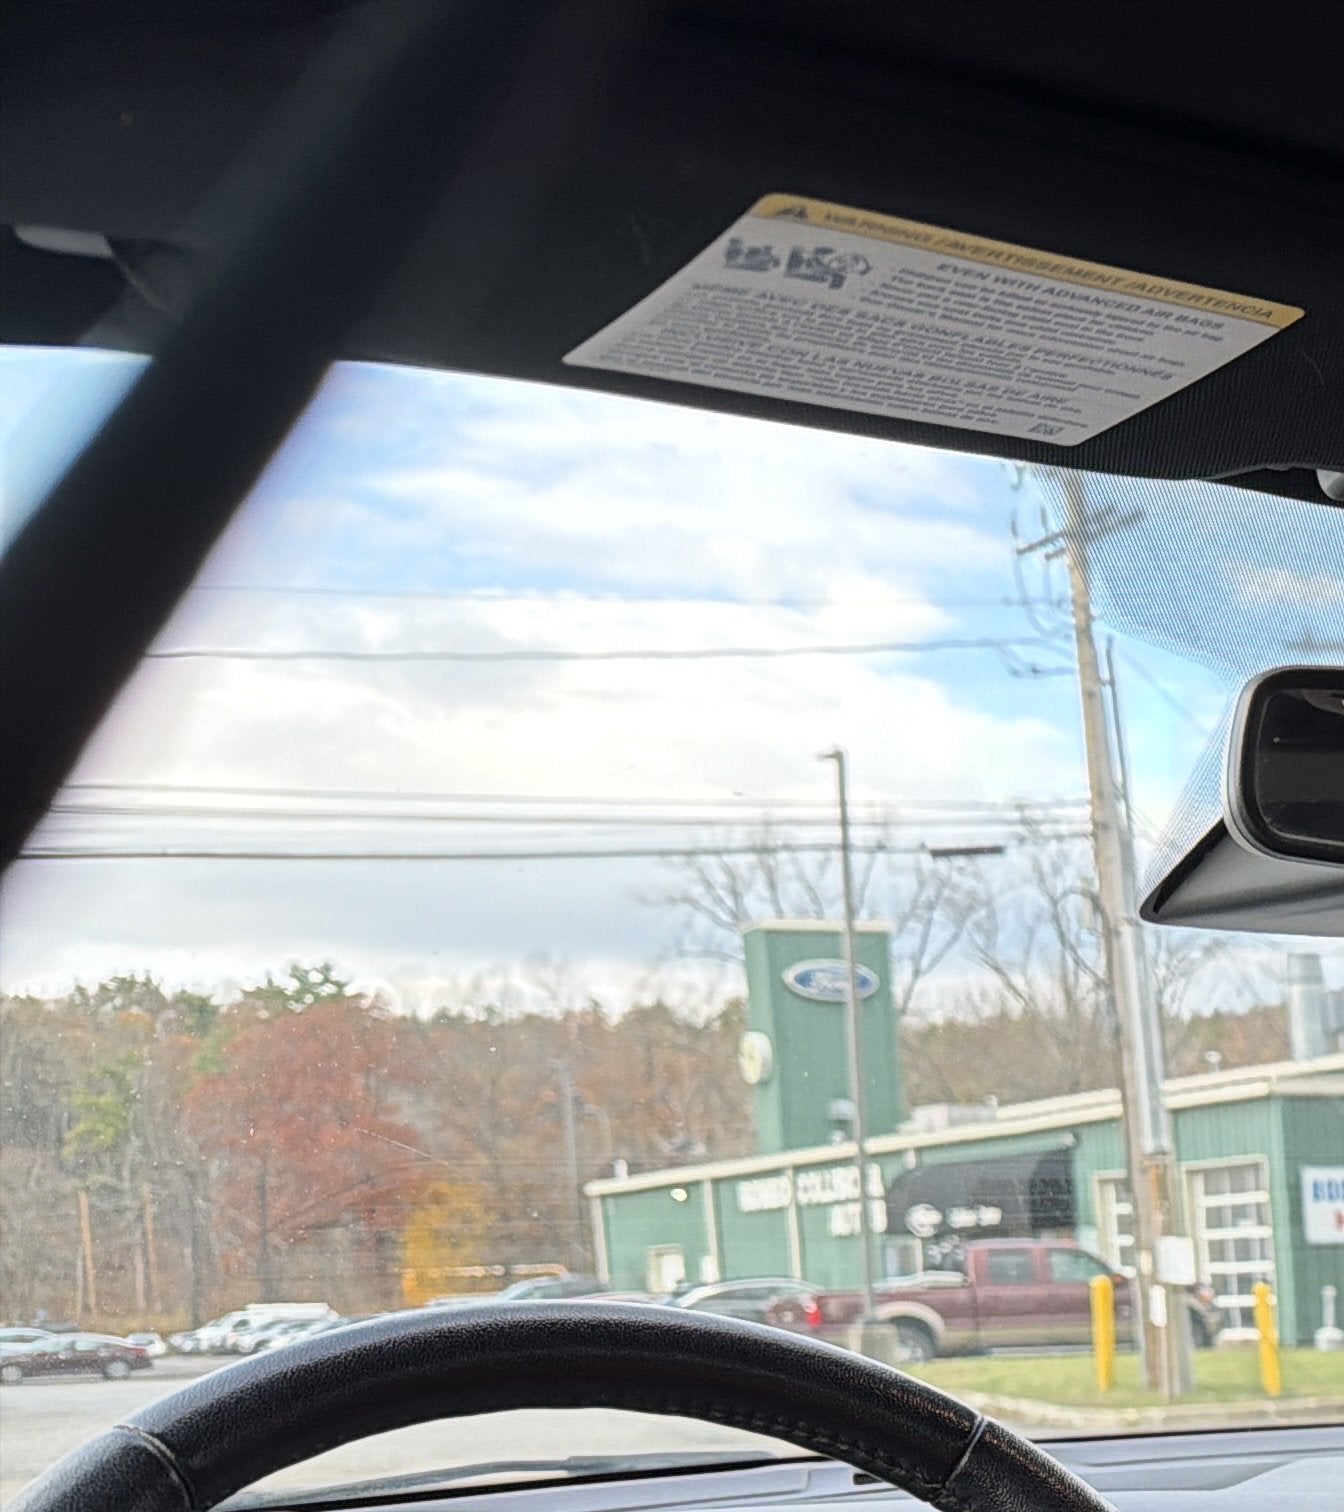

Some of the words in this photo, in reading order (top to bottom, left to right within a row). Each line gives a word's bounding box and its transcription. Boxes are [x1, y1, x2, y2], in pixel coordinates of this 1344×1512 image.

[931, 263, 992, 280] EVEN
[988, 275, 1044, 291] WITH
[1038, 286, 1144, 312] ADVANCED
[1139, 308, 1175, 319] AIR
[1171, 315, 1226, 330] BAGS
